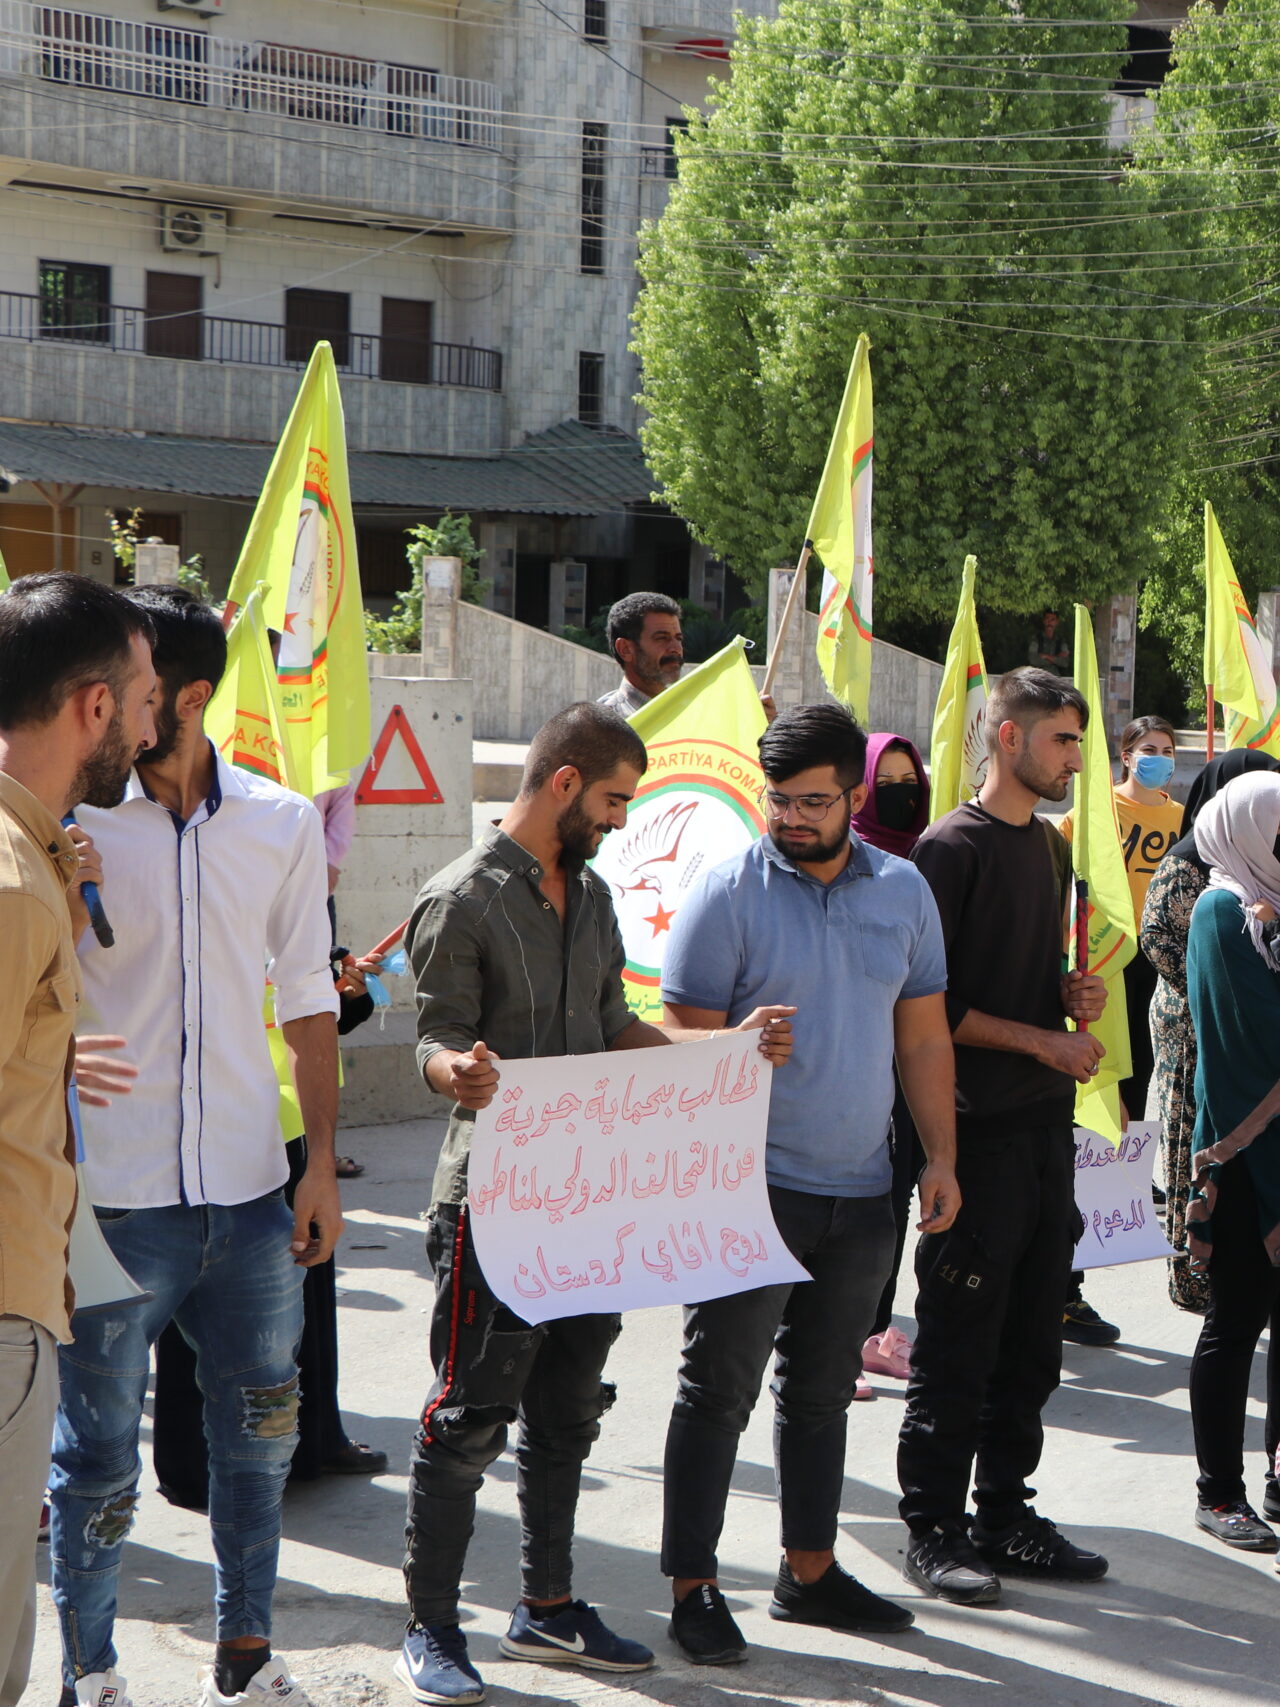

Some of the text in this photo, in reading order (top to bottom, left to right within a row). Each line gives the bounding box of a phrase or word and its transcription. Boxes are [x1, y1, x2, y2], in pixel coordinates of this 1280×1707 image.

[717, 760, 764, 800] KOMA
[494, 1049, 760, 1147] نطالب بحماية جوية
[543, 1145, 627, 1225] الدولي
[632, 1140, 718, 1199] التحالف
[513, 1221, 637, 1300] كردستان
